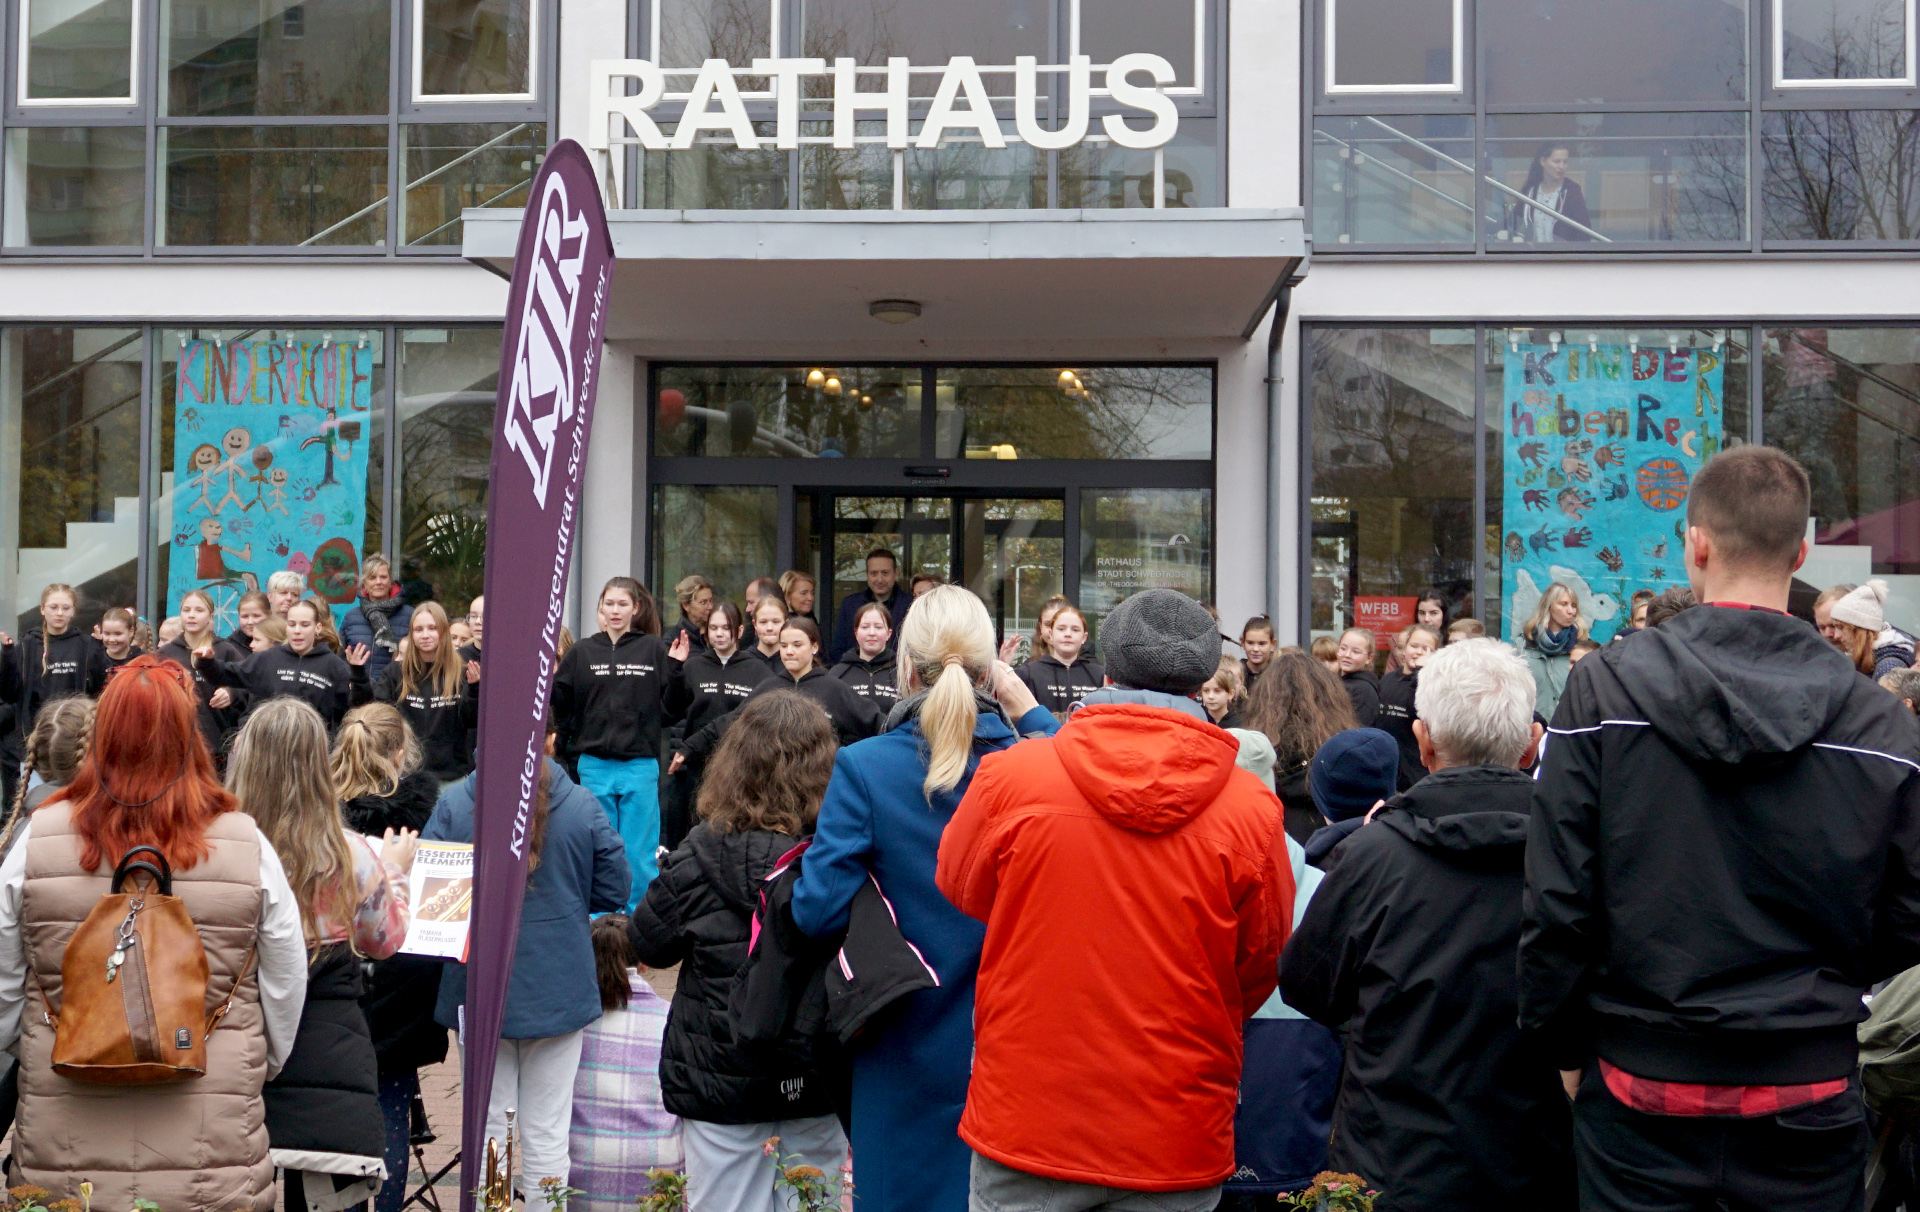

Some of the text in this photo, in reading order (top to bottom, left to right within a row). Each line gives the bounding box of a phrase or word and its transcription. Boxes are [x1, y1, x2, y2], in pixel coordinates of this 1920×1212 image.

[590, 52, 1179, 150] RATHAUS
[177, 341, 369, 411] KINDERRECHTE
[1523, 348, 1718, 417] KINDER
[1511, 393, 1718, 464] haben Rech
[510, 264, 604, 860] Kinder- und Jugendrat Schwedt/Oder
[1097, 557, 1142, 567] RATHAUS
[1097, 570, 1123, 578] STADT
[1360, 602, 1399, 615] WFBB
[417, 849, 474, 859] ESSENTIA
[780, 1076, 806, 1094] CHILL
